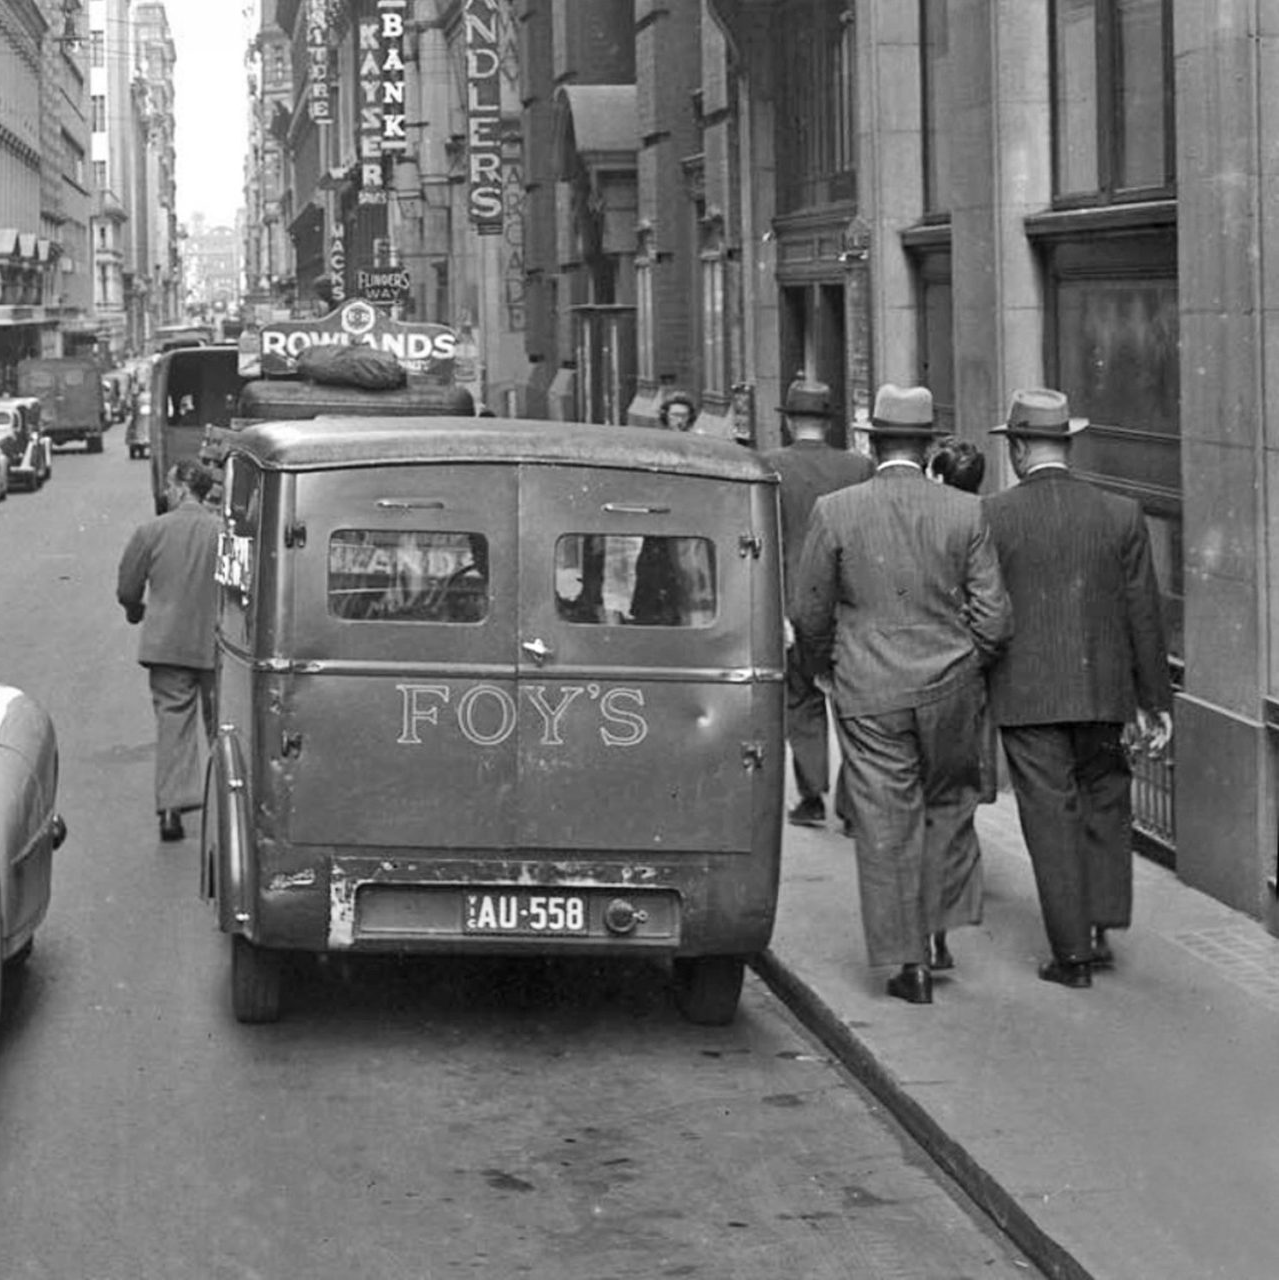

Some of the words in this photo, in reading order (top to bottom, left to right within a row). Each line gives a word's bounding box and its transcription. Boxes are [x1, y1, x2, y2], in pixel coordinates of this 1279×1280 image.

[358, 23, 384, 186] KAYSER
[380, 13, 405, 137] BANK
[330, 223, 345, 301] MACKS
[358, 271, 411, 290] FLINDERS
[366, 288, 401, 299] WAY
[395, 683, 649, 747] FOY'S
[467, 895, 477, 929] VIC
